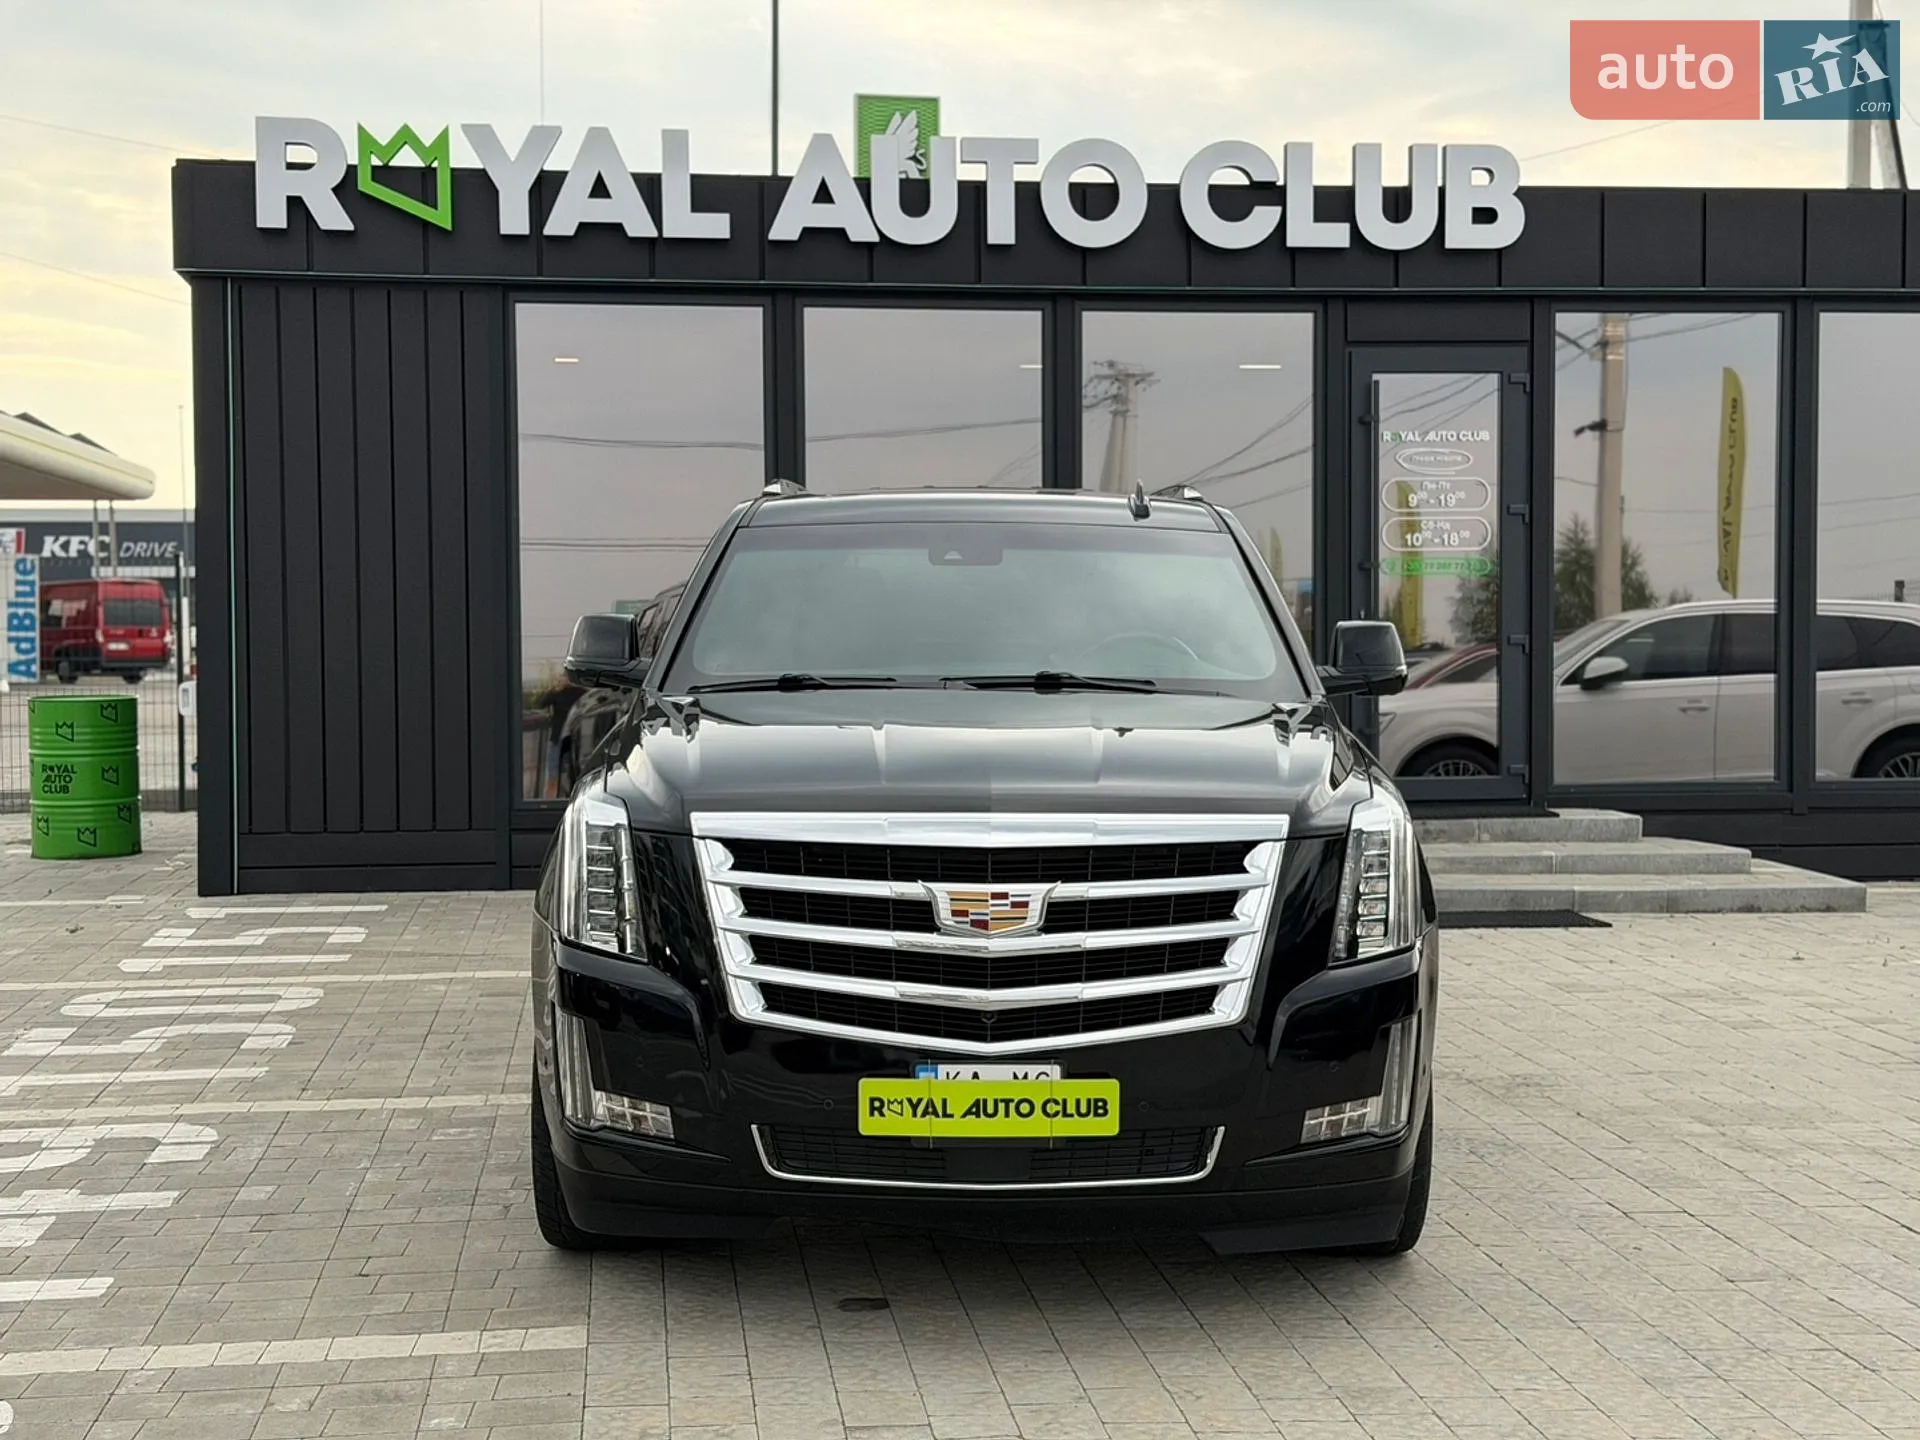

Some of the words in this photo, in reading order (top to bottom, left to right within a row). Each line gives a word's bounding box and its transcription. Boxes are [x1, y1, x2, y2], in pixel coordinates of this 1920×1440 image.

[767, 132, 1148, 250] AUTO
[1180, 139, 1526, 251] CLUB
[1423, 431, 1457, 442] AUTO
[1459, 430, 1490, 442] CLUB
[41, 534, 111, 558] KFC
[119, 541, 178, 558] DRIVE
[7, 558, 37, 680] AdBlue
[42, 774, 73, 784] AUTO
[42, 784, 70, 795] CLUB
[960, 1097, 1036, 1119] AUTO
[1041, 1097, 1109, 1119] CLUB
